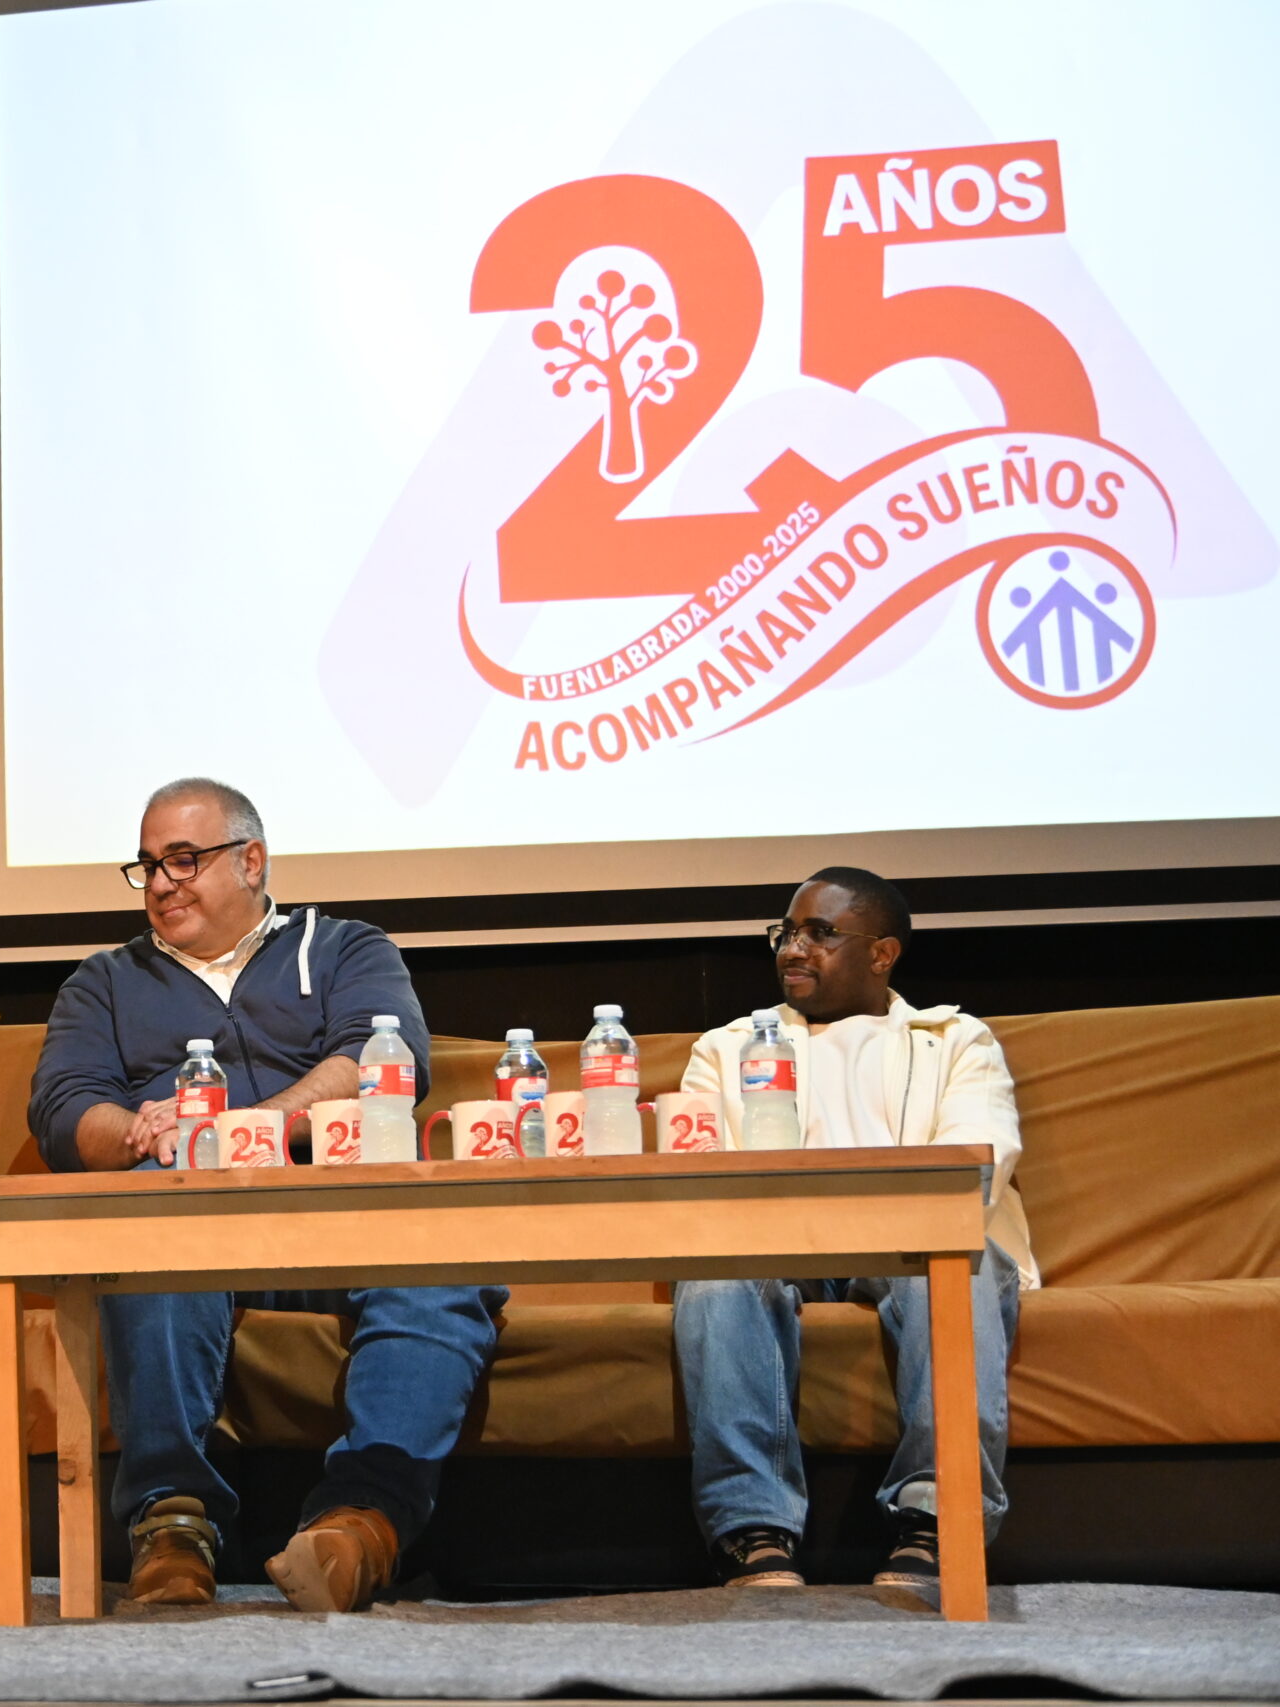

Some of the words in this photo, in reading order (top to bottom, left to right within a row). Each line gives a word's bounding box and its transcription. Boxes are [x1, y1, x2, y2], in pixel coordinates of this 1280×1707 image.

[822, 157, 1048, 236] AÑOS
[469, 139, 1100, 602] 25
[514, 523, 889, 772] ACOMPAÑANDO
[886, 445, 1125, 543] SUEÑOS
[521, 602, 712, 700] FUENLABRADA
[705, 501, 820, 609] 2000-2025
[230, 1127, 275, 1162] 25
[470, 1121, 515, 1156] 25
[556, 1112, 584, 1149] 2
[671, 1113, 717, 1150] 25
